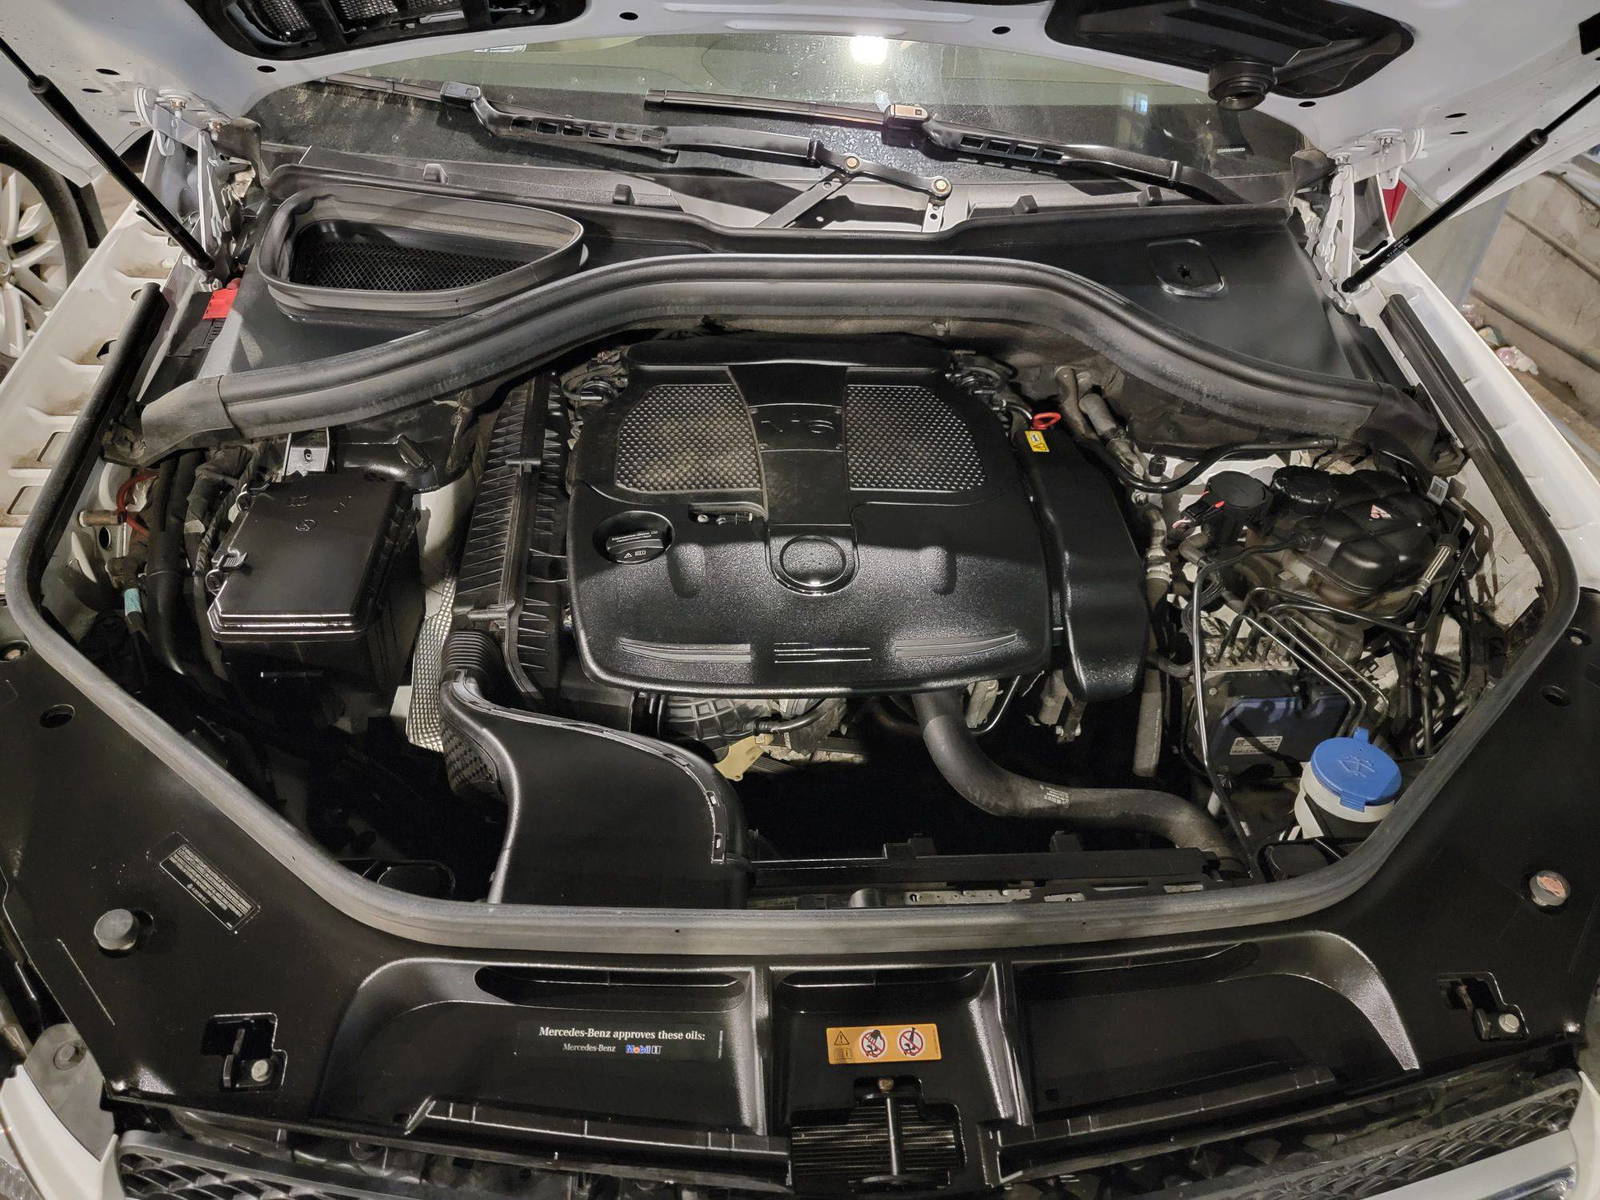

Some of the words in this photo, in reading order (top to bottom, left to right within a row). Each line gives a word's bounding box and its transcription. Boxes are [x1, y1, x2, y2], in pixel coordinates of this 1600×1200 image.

[538, 1026, 611, 1038] Mercedes-Benz
[612, 1030, 656, 1041] approves
[658, 1029, 684, 1040] these
[685, 1031, 706, 1041] oils:
[562, 1043, 616, 1053] Mercedes-Benz
